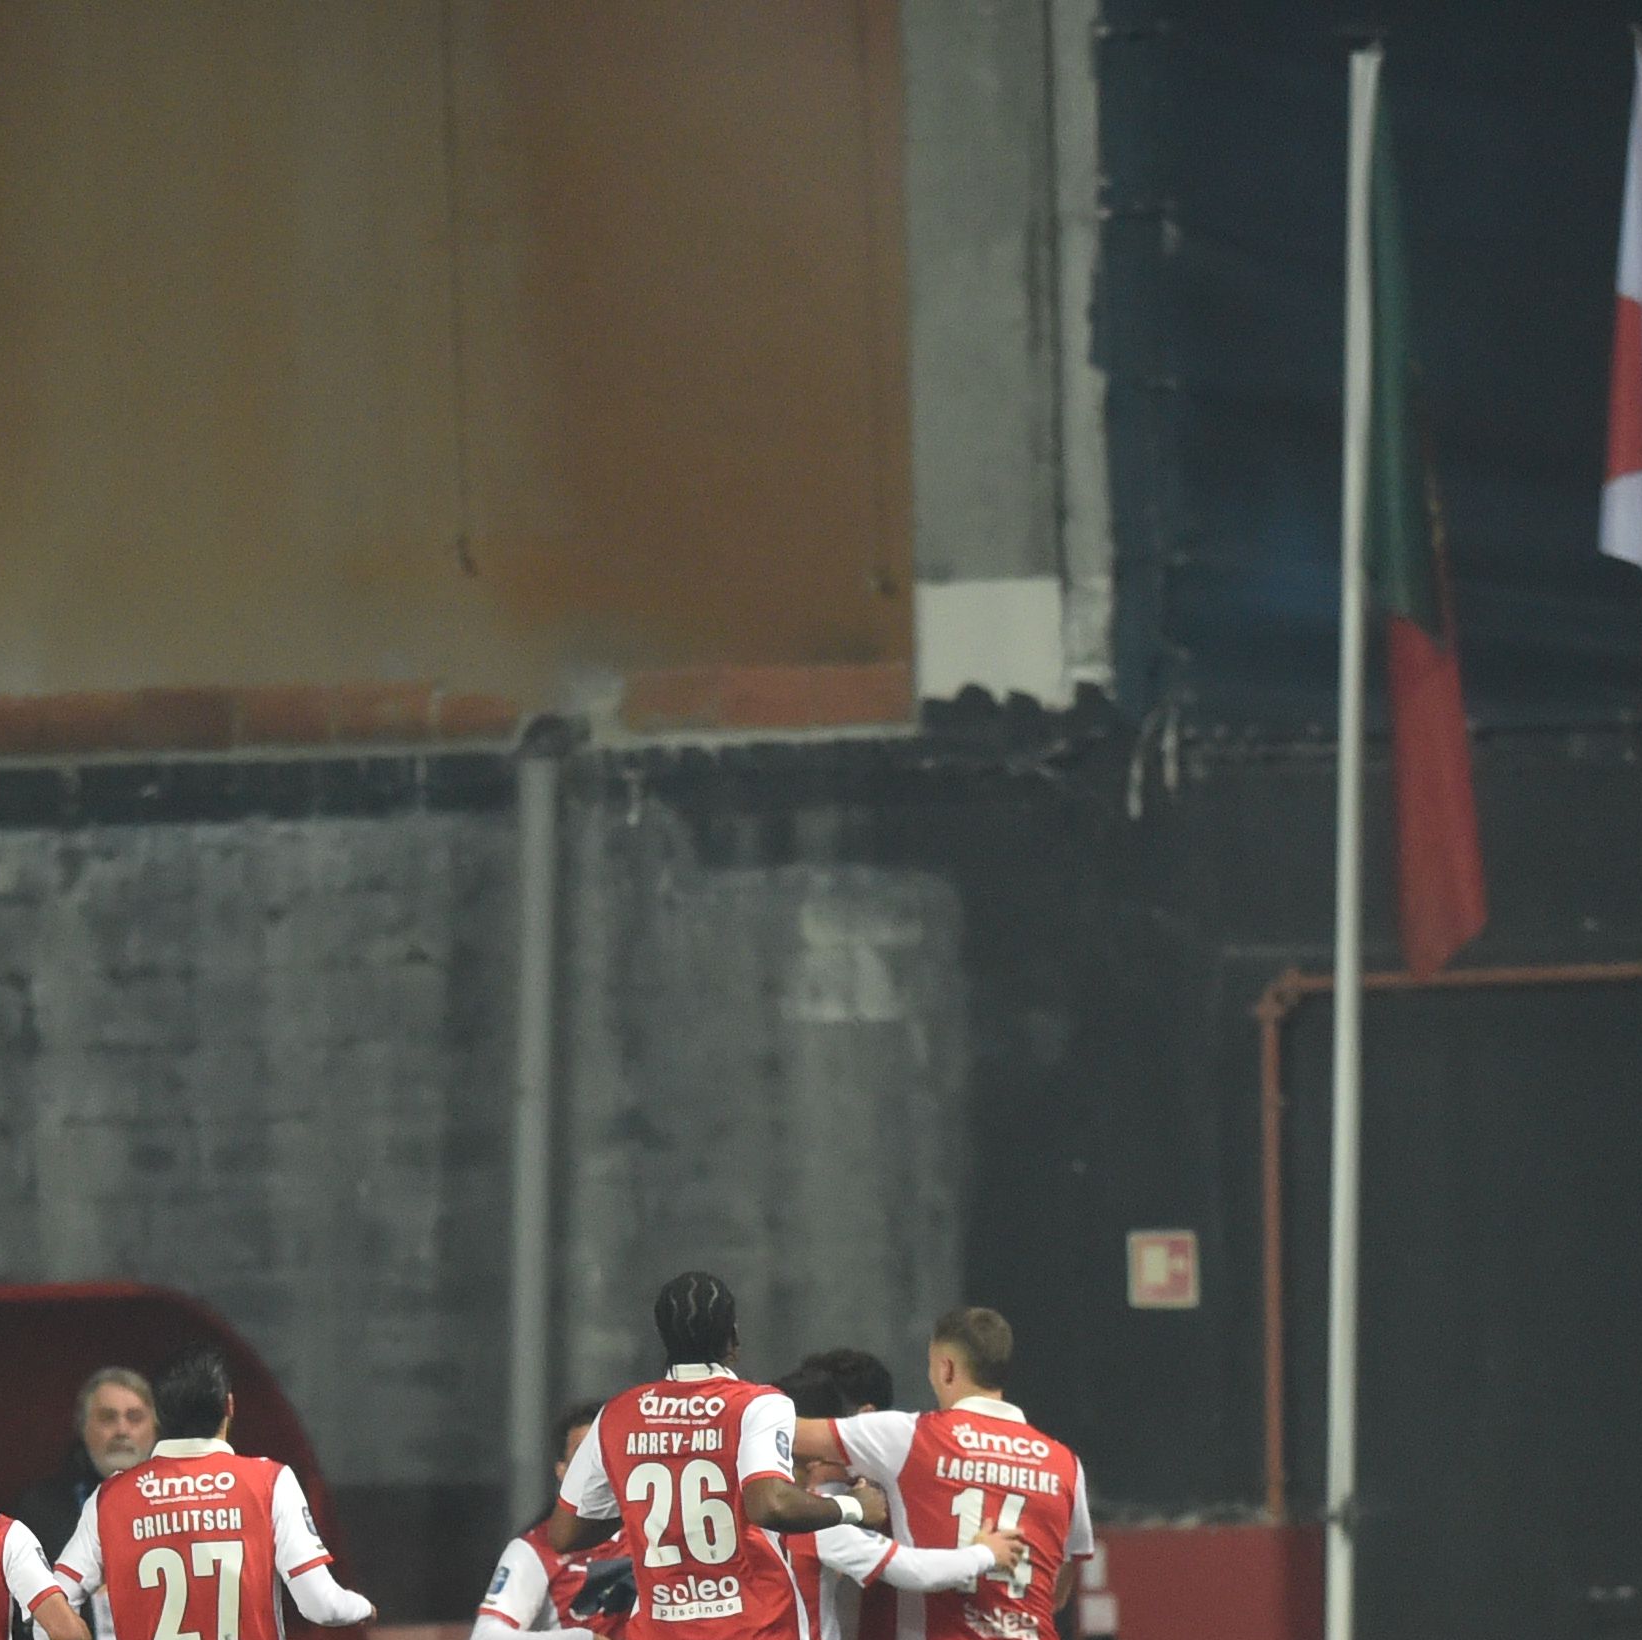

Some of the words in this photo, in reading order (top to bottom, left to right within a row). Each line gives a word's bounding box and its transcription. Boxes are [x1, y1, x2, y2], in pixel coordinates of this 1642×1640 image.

[638, 1388, 726, 1417] amco
[626, 1428, 723, 1455] ARREY-MBI
[952, 1423, 1050, 1458] amco
[135, 1470, 235, 1498] amco
[935, 1455, 1061, 1496] LAGERBIELKE
[132, 1507, 242, 1540] GRILLITSCH
[625, 1459, 737, 1567] 26
[652, 1574, 740, 1604] soleo
[660, 1602, 735, 1618] piscinas
